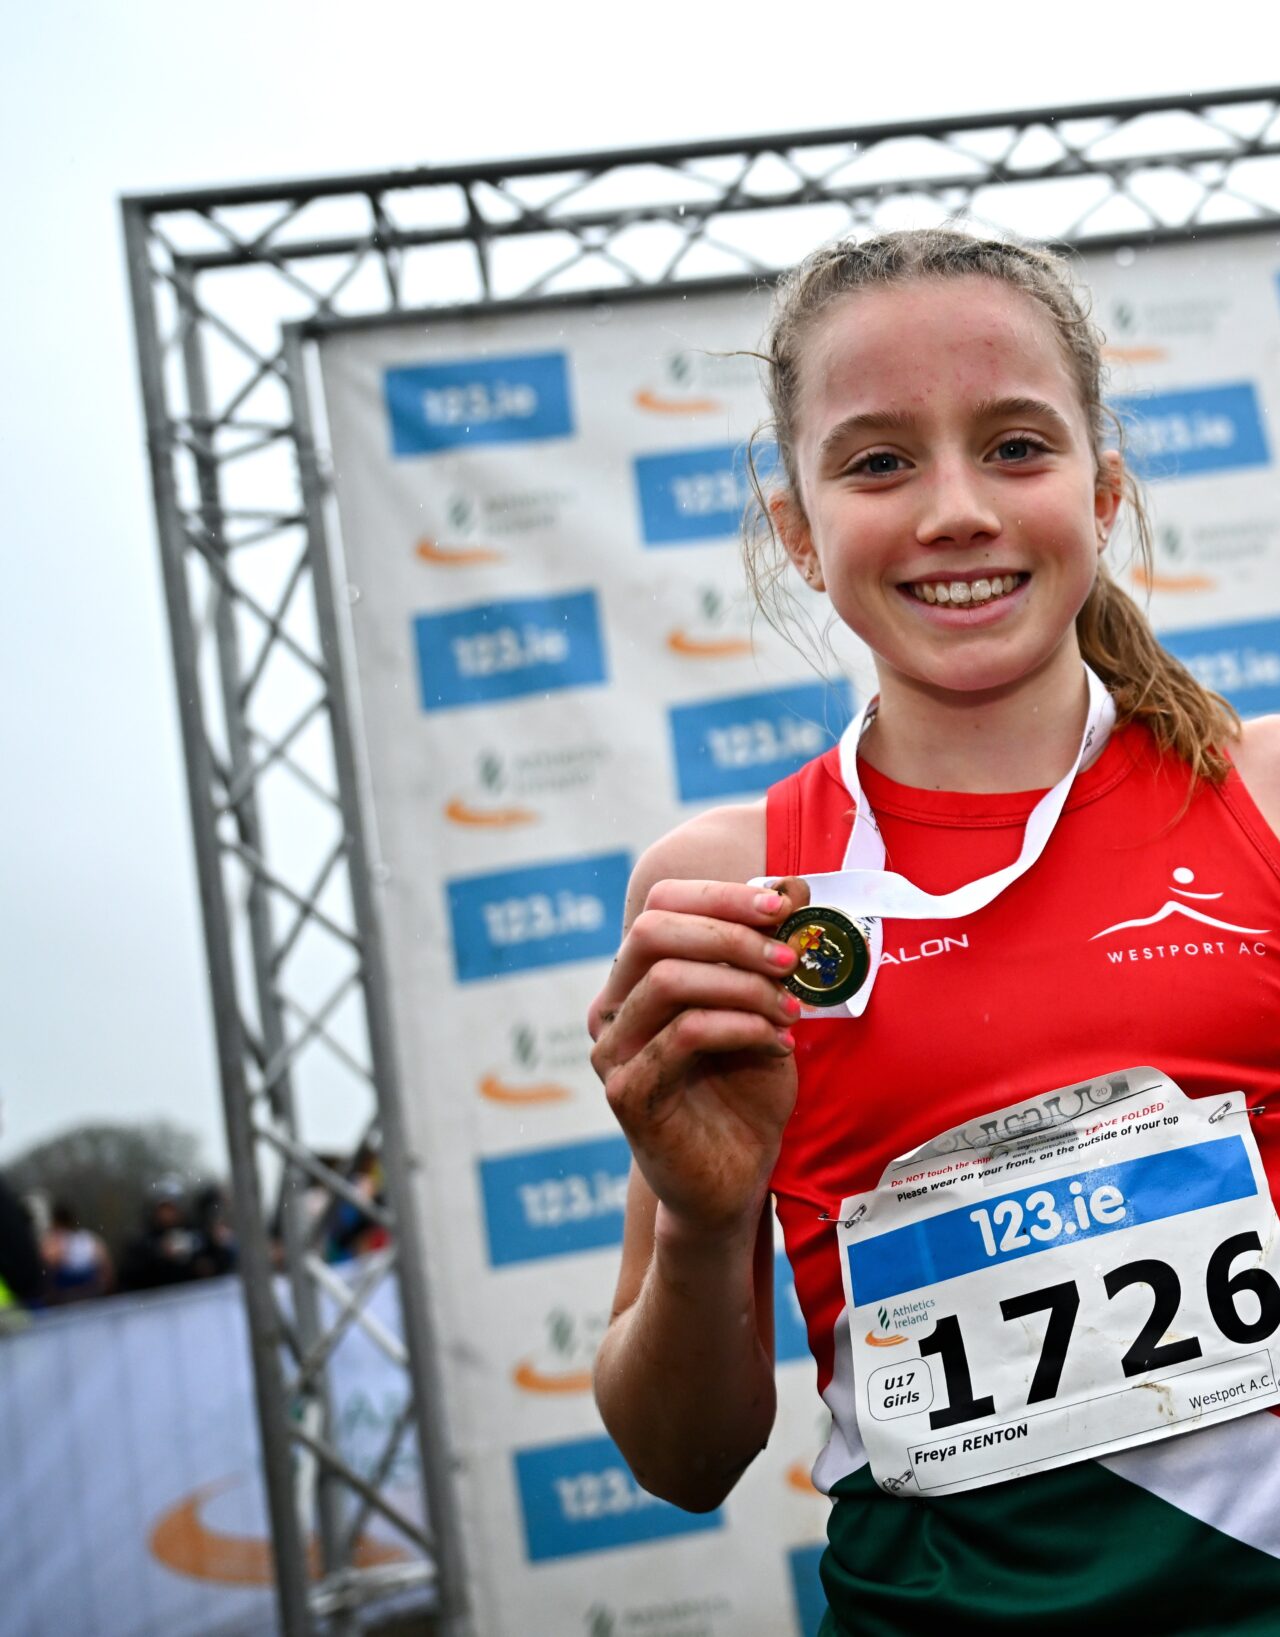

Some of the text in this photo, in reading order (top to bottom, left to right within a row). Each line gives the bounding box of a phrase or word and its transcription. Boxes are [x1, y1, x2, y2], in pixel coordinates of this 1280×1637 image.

[421, 381, 539, 427] 123.ie
[452, 624, 570, 678] 123.ie
[483, 892, 604, 944] 123.ie
[880, 933, 969, 965] ALON
[1107, 942, 1266, 964] WESTPORT AC
[891, 1180, 903, 1188] Do
[906, 1172, 925, 1183] NOT
[927, 1166, 953, 1178] touch
[955, 1161, 969, 1170] the
[1085, 1118, 1118, 1136] LEAVE
[1121, 1102, 1165, 1122] FOLDED
[897, 1115, 1179, 1203] Please wear on your front, on the outside of your top
[969, 1181, 1127, 1257] 123.ie
[892, 1299, 935, 1318] Athletics
[894, 1311, 928, 1329] Ireland
[883, 1391, 920, 1409] Girls
[884, 1373, 915, 1390] U17
[1188, 1374, 1274, 1409] Westport A.C.
[914, 1424, 1028, 1465] Freya RENTON
